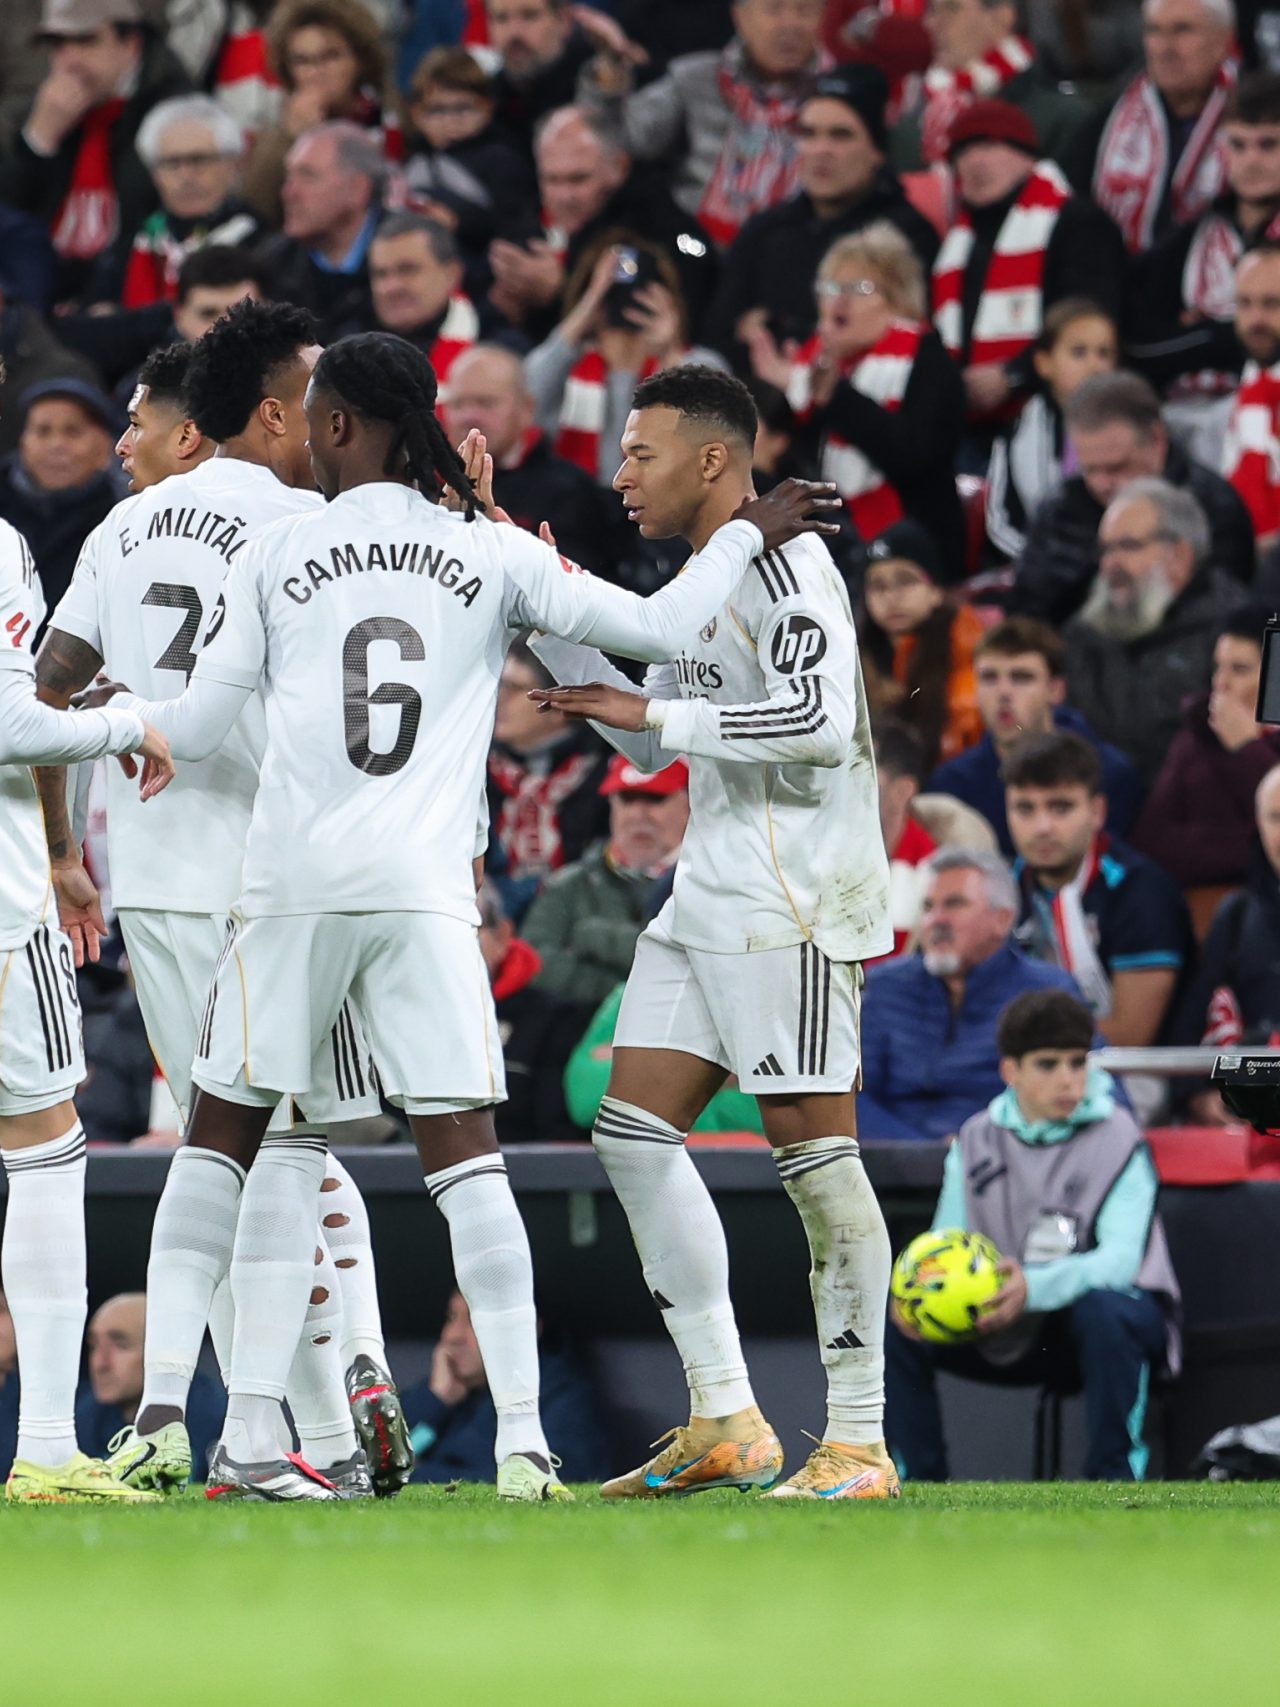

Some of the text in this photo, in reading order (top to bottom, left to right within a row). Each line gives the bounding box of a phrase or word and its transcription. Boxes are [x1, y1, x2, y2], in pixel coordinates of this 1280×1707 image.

[119, 527, 140, 558] E.
[282, 542, 484, 608] CAMAVINGA
[773, 614, 823, 676] hp
[342, 615, 426, 777] 6
